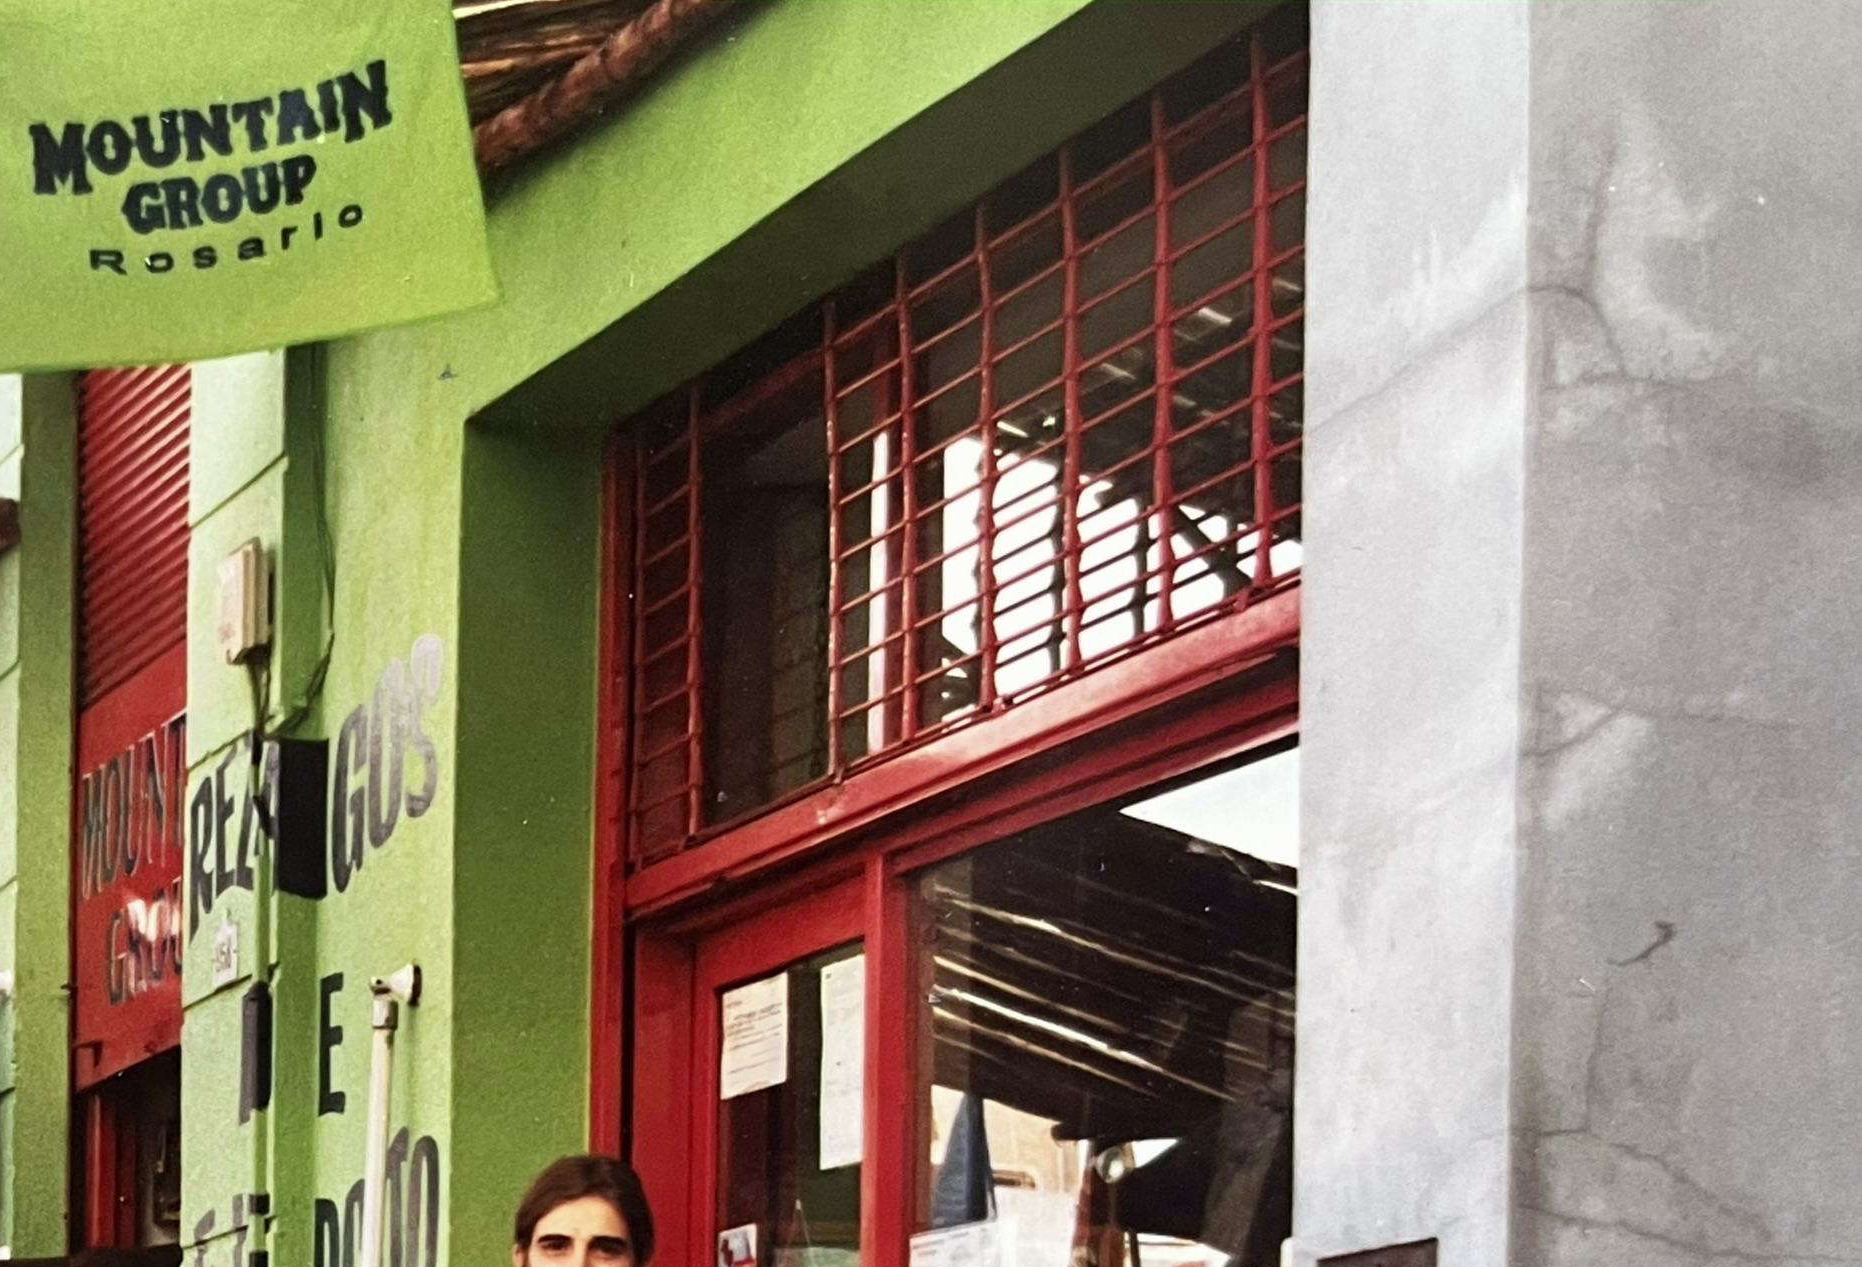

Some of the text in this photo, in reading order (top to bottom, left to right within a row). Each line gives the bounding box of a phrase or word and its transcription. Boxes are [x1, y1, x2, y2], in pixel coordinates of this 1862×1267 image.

[29, 59, 393, 195] MOUNTAIN
[121, 154, 317, 234] GROUP
[89, 203, 365, 275] Rosario
